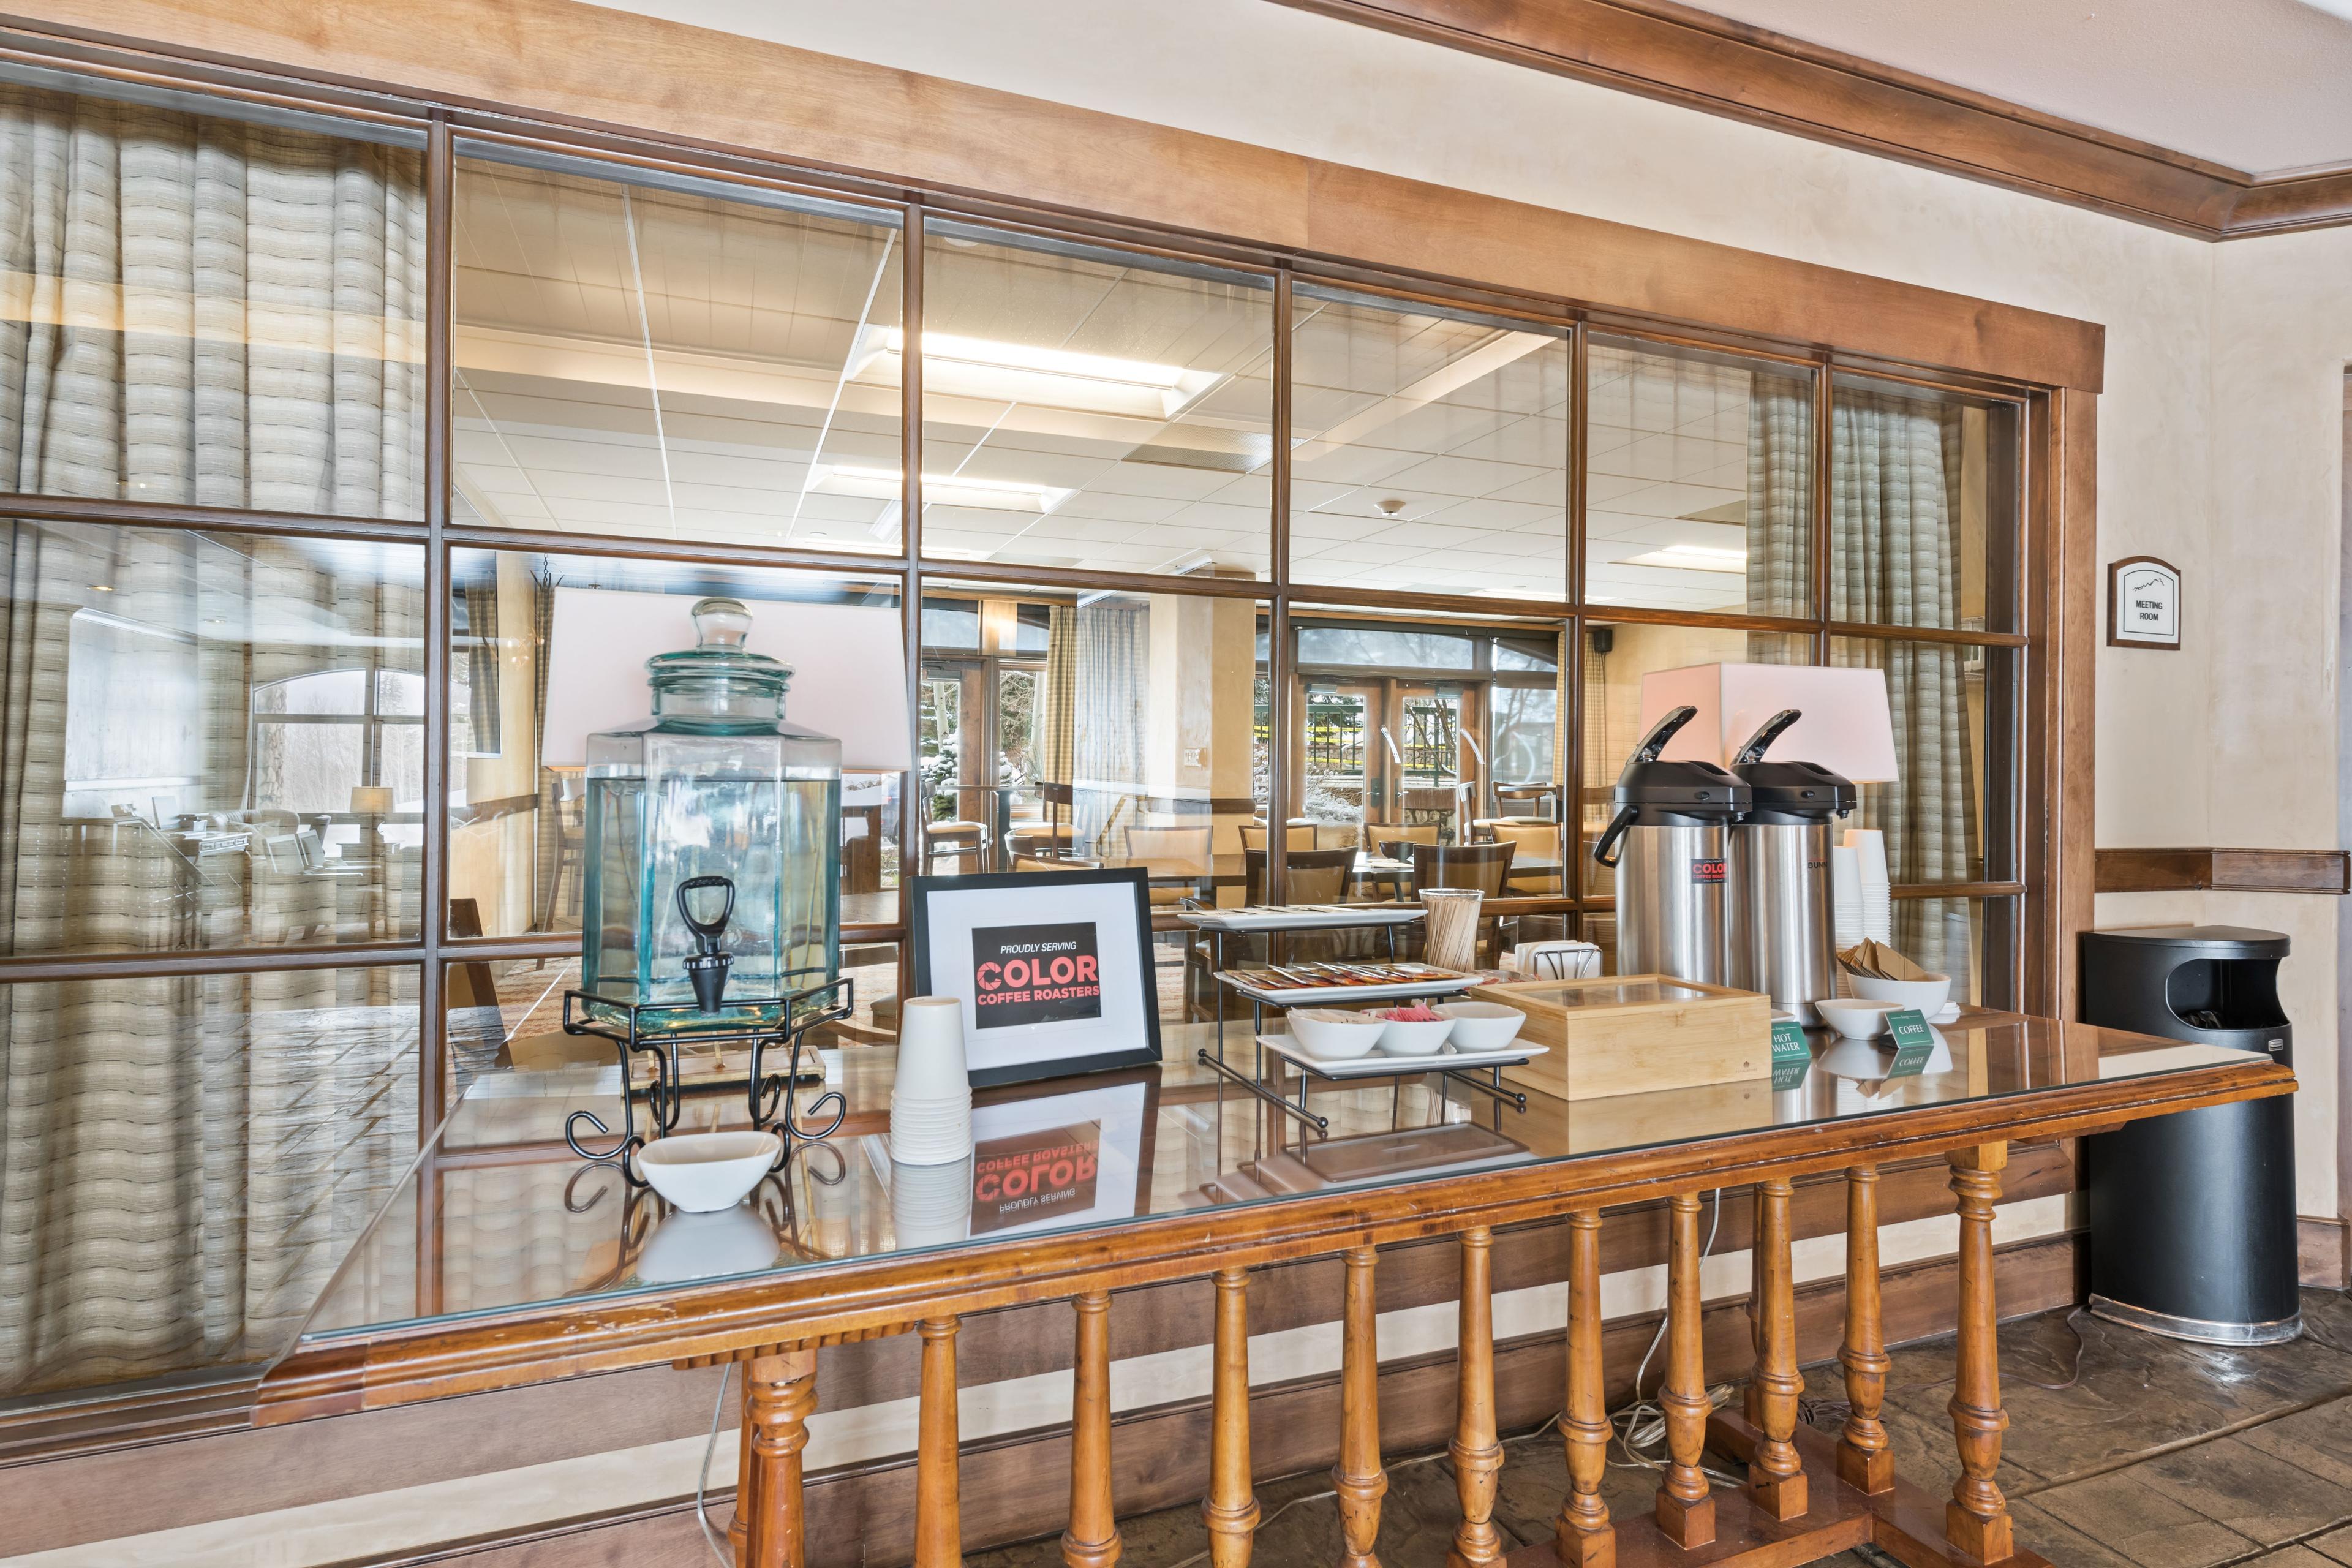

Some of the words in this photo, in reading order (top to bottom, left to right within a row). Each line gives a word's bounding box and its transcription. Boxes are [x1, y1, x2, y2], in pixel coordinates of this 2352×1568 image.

[2136, 600, 2163, 609] MEETING
[2139, 612, 2158, 621] ROOM
[1000, 943, 1040, 954] PROUDLY
[1041, 941, 1077, 952] SERVING
[976, 955, 1098, 991] COLOR
[978, 990, 1031, 1005] COFFEE
[1034, 985, 1100, 1001] ROASTERS
[1898, 1024, 1924, 1035] COFFEE
[1773, 1033, 1792, 1042] HOT
[1772, 1042, 1800, 1052] WATER
